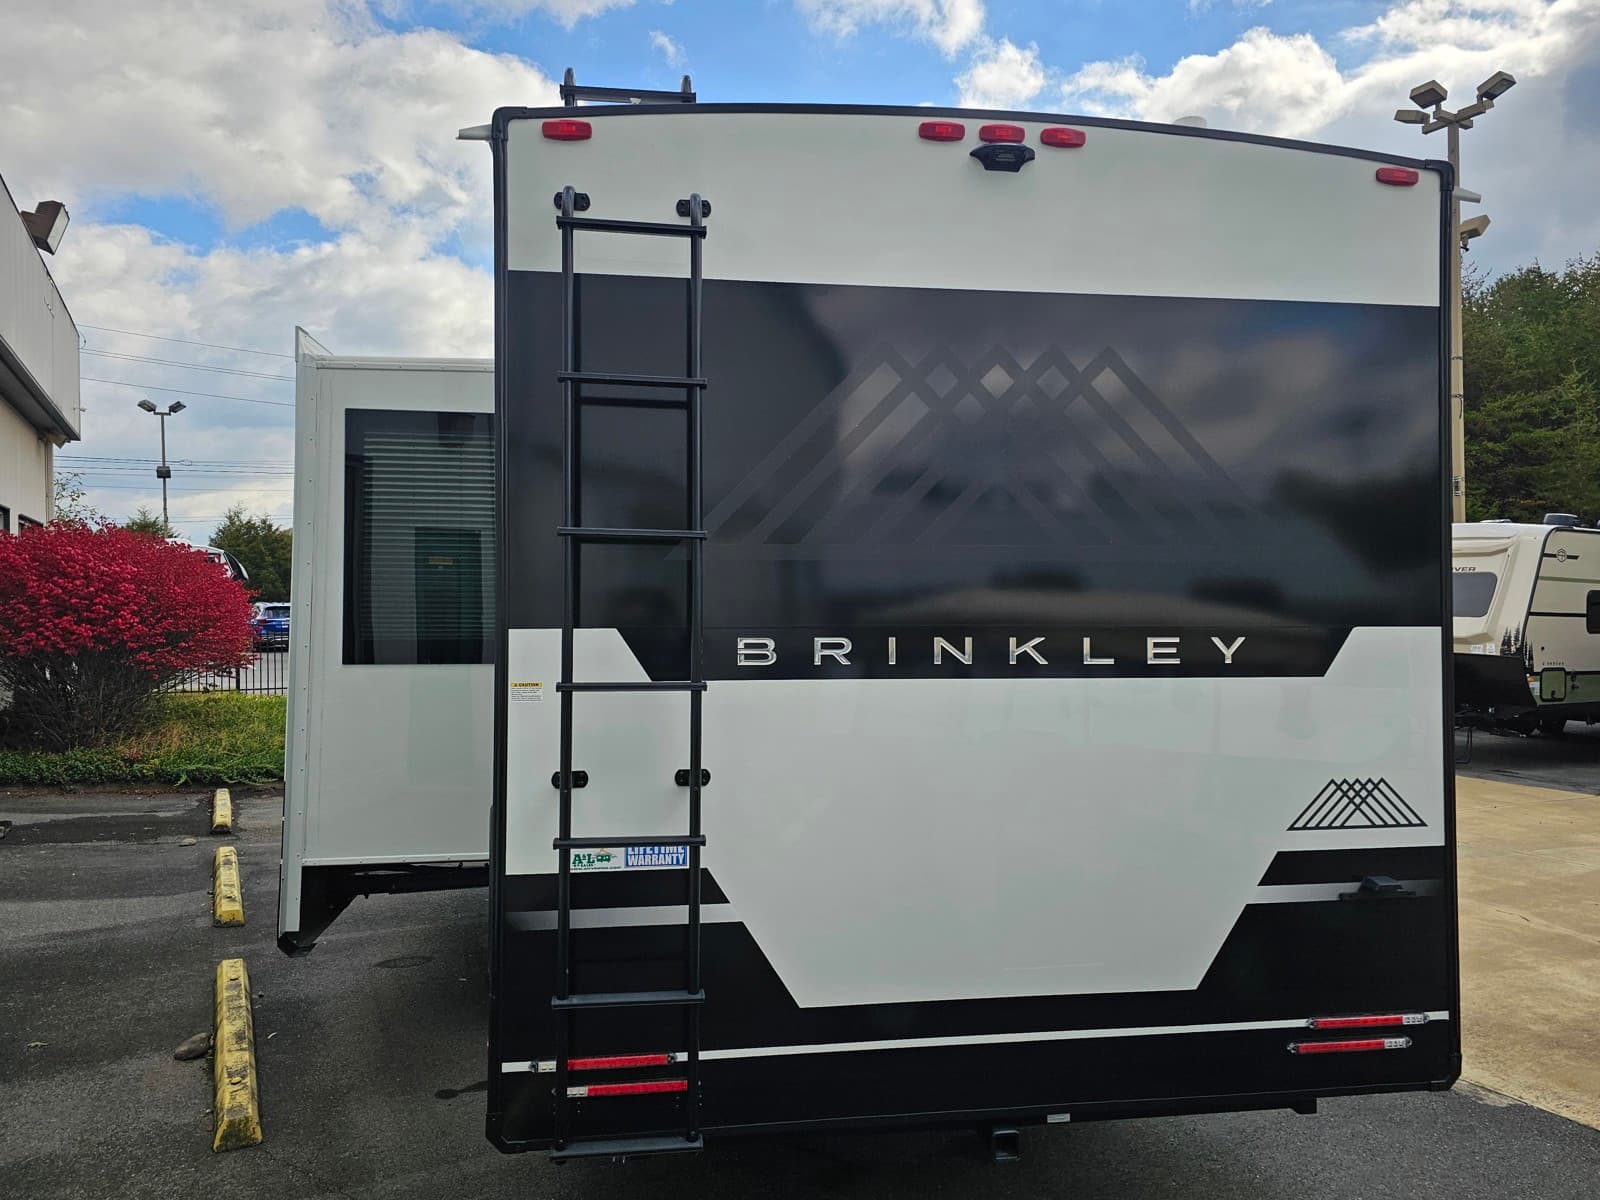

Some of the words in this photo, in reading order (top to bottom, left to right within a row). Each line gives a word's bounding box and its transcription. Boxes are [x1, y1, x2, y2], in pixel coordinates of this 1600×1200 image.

[737, 637, 1247, 666] BRINKLEY
[627, 846, 685, 854] LIFETIME
[627, 854, 685, 866] WARRANTY
